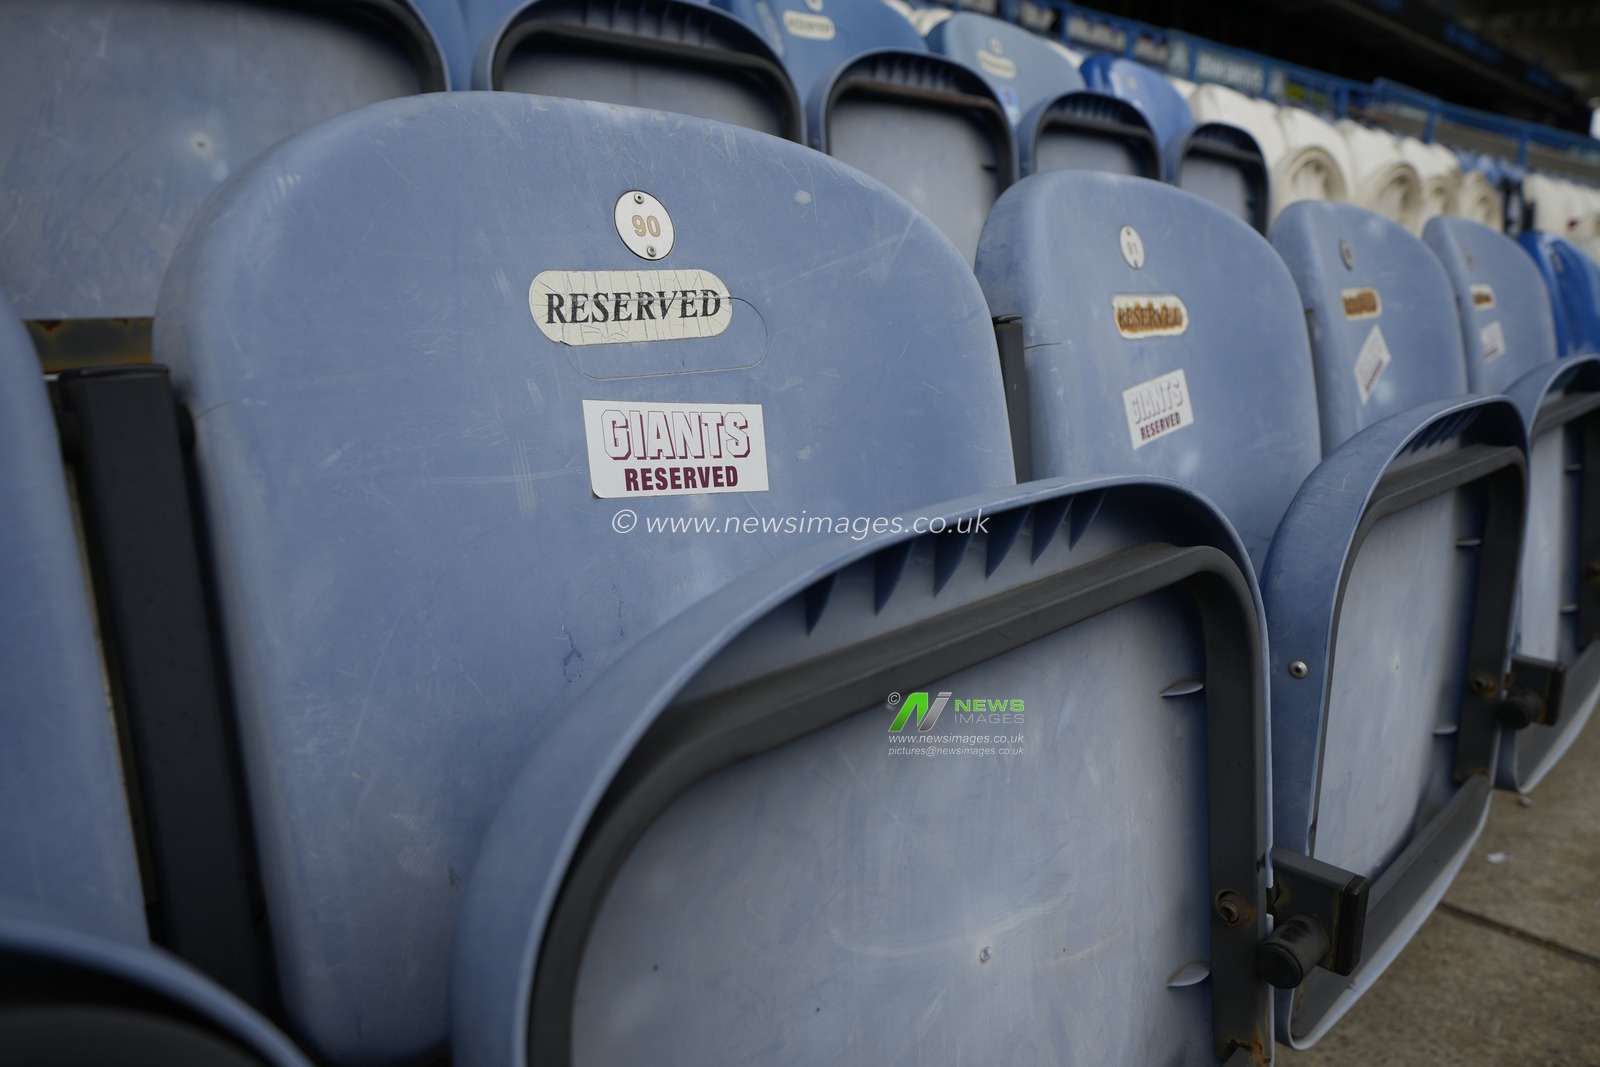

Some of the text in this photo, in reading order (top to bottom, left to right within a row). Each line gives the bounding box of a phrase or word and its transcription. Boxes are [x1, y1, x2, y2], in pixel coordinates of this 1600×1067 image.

[632, 215, 661, 237] 90
[545, 289, 721, 324] RESERVED
[601, 409, 751, 460] GIANTS
[1140, 411, 1181, 440] RESERVED
[624, 465, 739, 492] RESERVED
